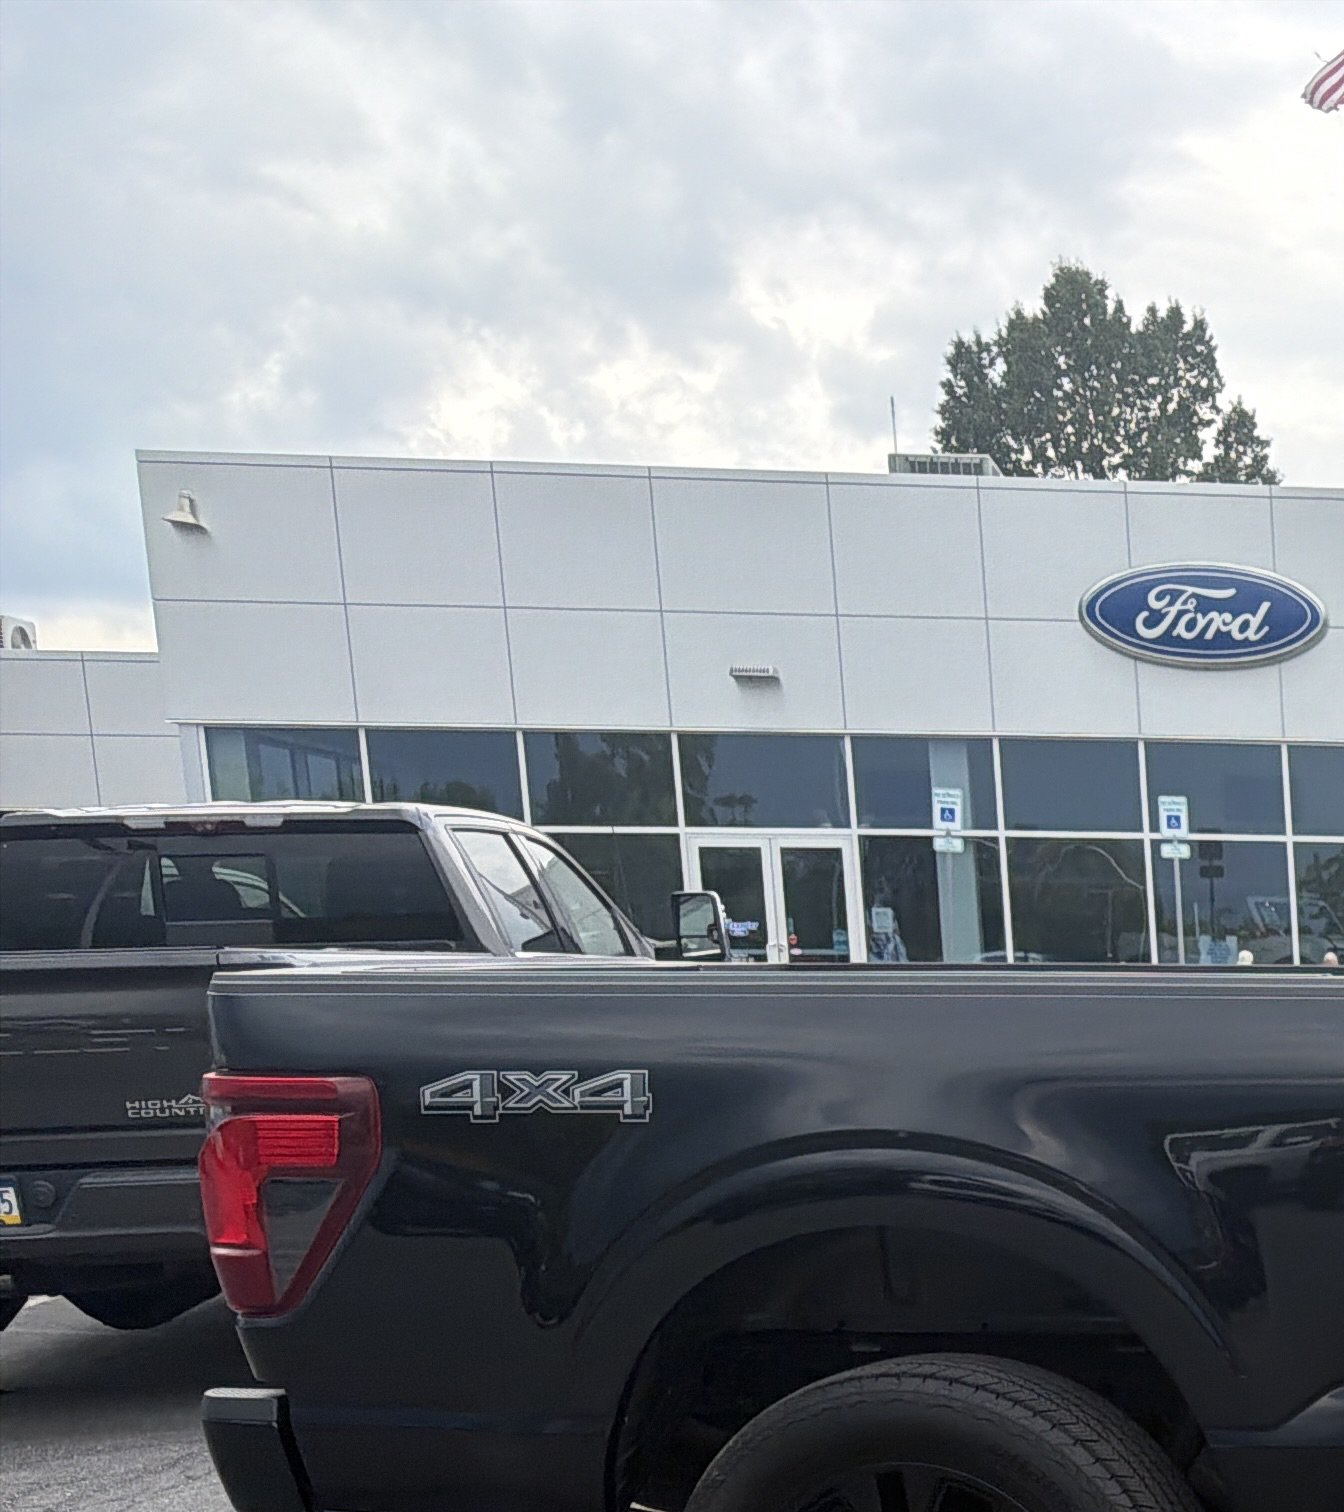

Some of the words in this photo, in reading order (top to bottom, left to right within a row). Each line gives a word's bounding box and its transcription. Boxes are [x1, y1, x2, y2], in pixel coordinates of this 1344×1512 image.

[1135, 583, 1272, 641] Ford
[125, 1099, 176, 1110] HIGH
[127, 1106, 205, 1118] COUNT
